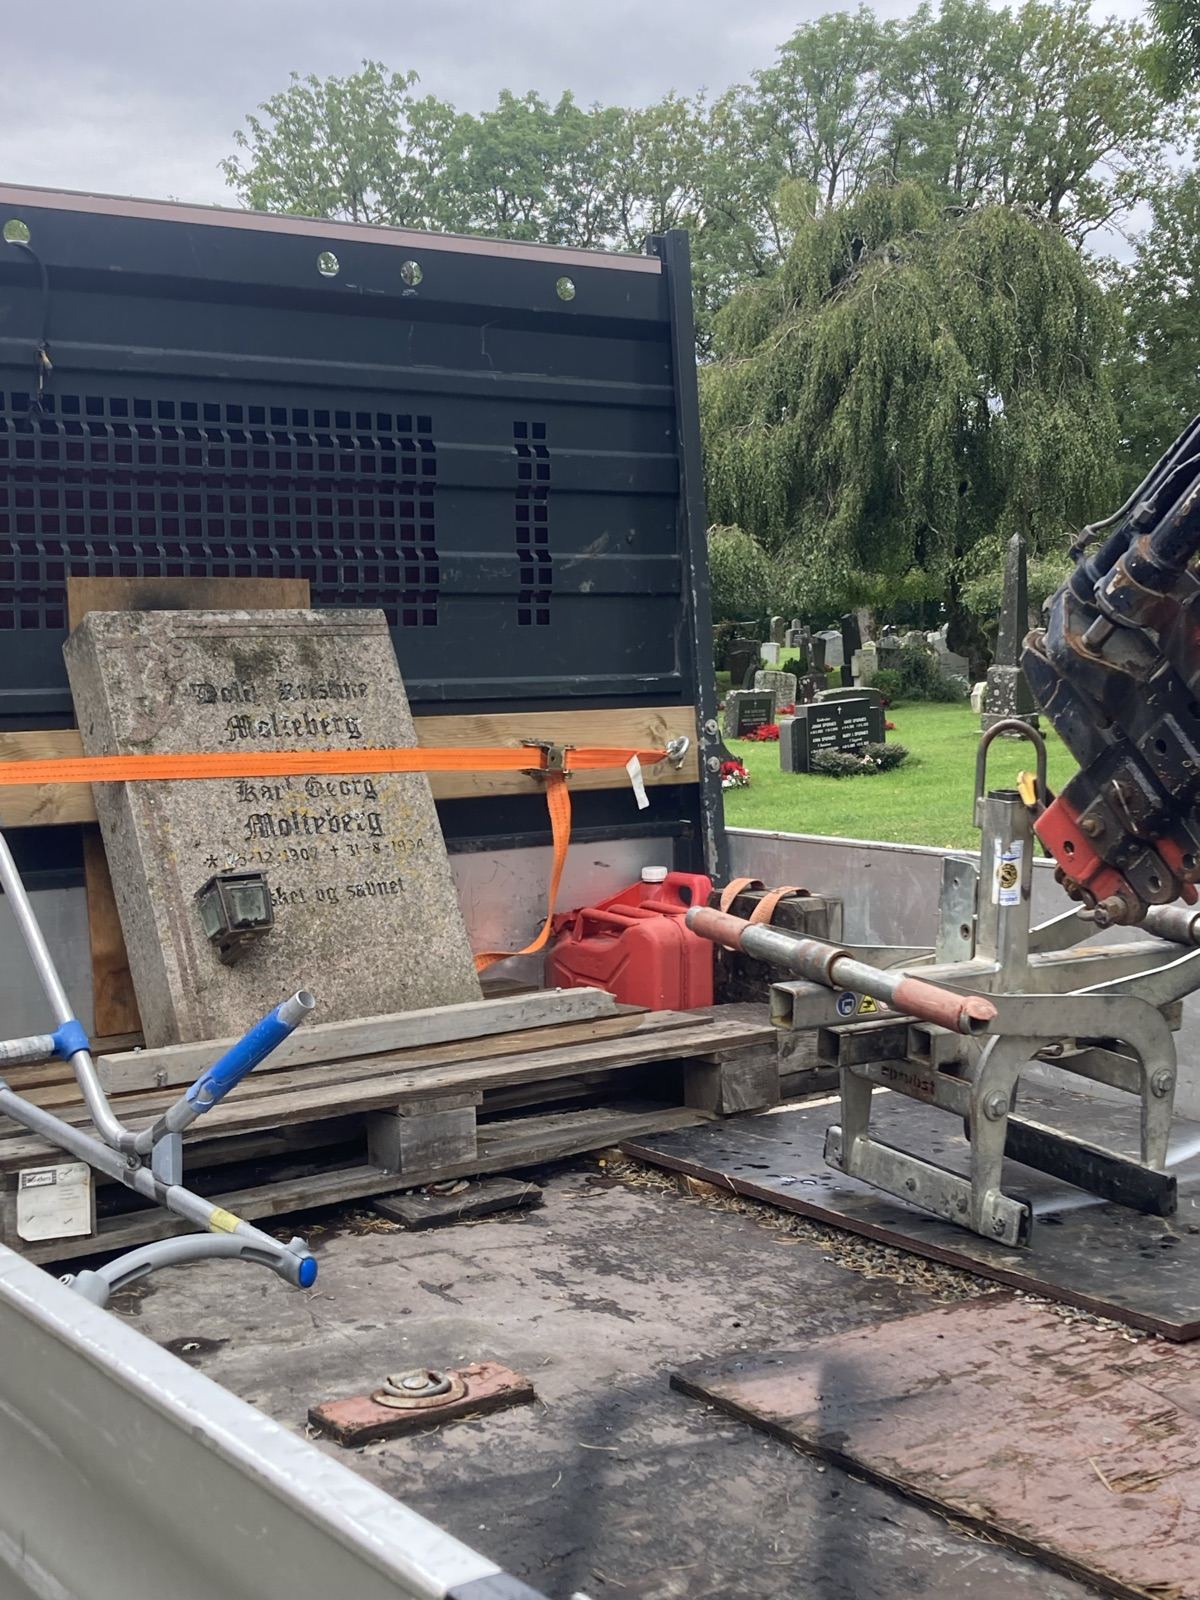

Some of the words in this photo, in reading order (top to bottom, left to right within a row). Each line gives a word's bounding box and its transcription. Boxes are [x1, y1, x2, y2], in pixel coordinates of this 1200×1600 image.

[235, 776, 292, 803] Karl
[304, 776, 379, 801] Georg
[244, 809, 386, 842] Molteberg
[315, 887, 341, 905] og
